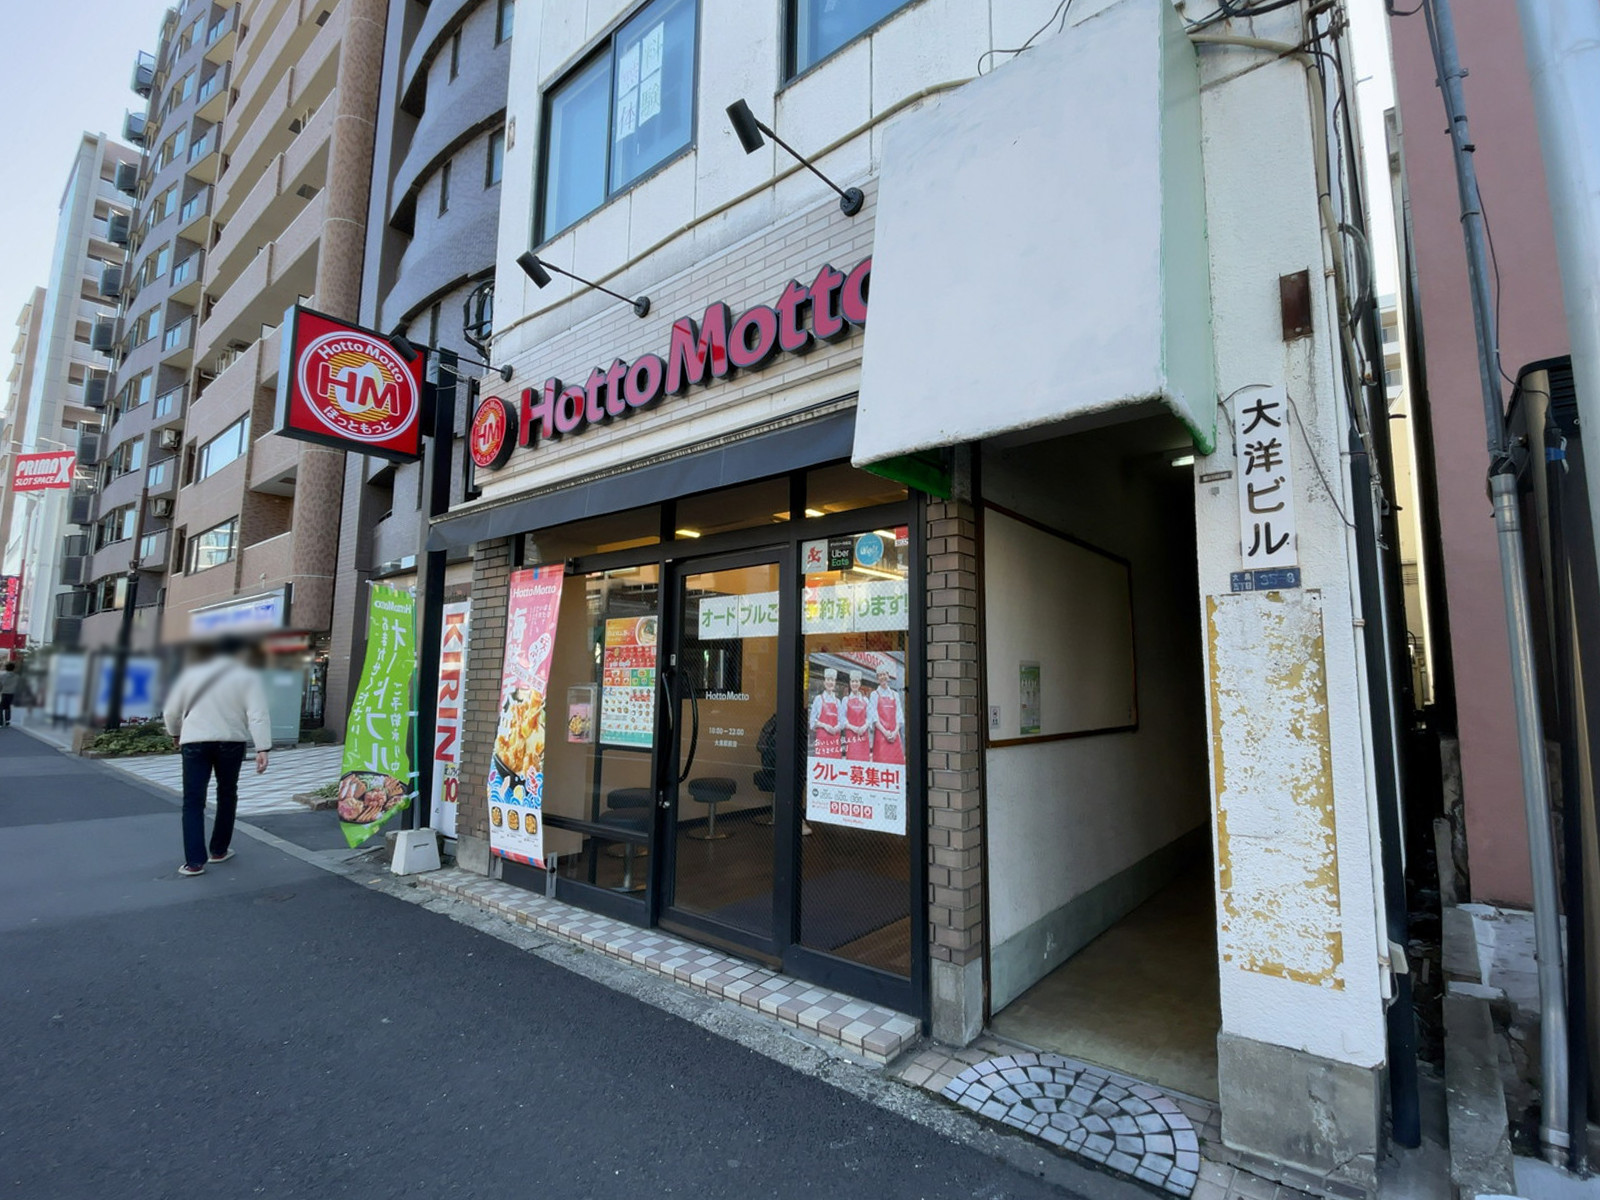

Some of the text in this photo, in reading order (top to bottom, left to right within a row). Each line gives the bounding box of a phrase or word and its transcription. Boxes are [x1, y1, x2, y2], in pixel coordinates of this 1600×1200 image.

[317, 341, 404, 383] Hotto Motto
[316, 361, 400, 416] HM
[323, 405, 393, 434] ほっともっと
[473, 418, 502, 449] HM
[15, 476, 55, 486] SLOT SPACE
[16, 455, 76, 483] PRIMAX
[1242, 398, 1290, 557] 大洋ビル
[831, 549, 850, 559] Uber
[831, 558, 850, 567] Eats
[435, 612, 465, 763] KIRIN
[812, 762, 900, 790] クルー募集中!
